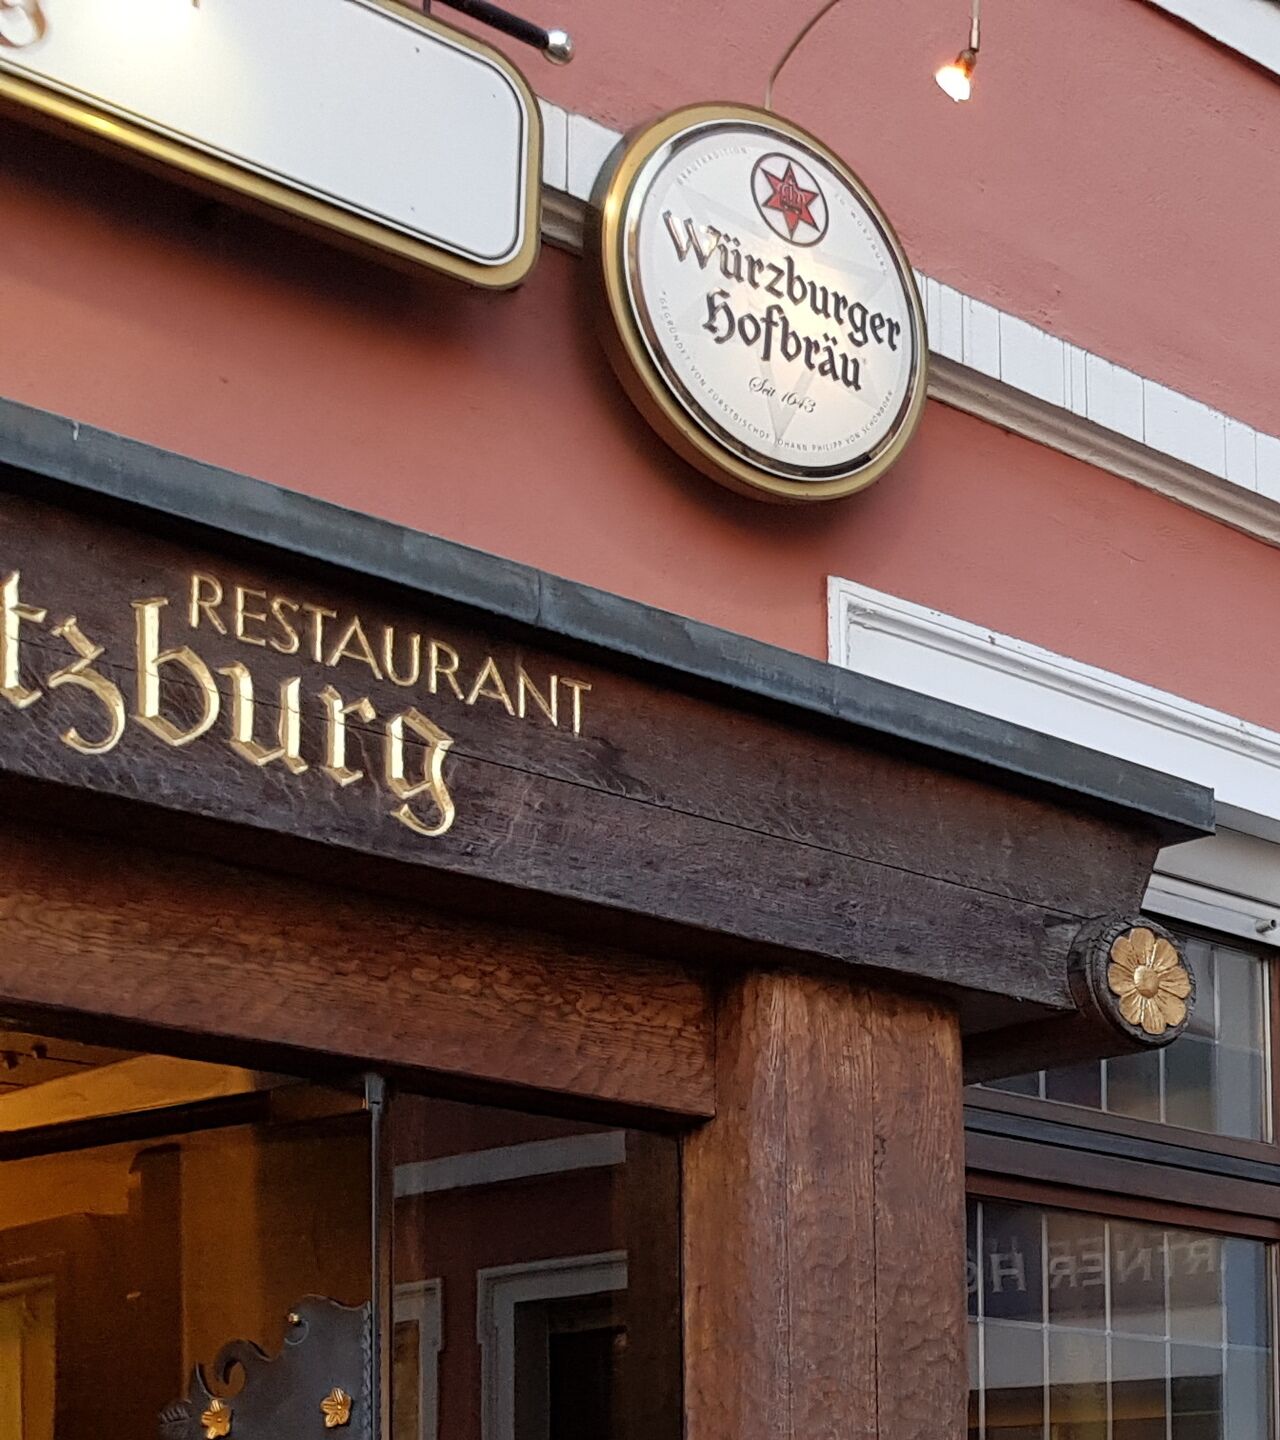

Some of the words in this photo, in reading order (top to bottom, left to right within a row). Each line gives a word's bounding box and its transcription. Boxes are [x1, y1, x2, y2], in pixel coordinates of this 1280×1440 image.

[662, 209, 901, 351] Würzburger
[702, 286, 862, 392] Hofbräu
[748, 376, 777, 398] Seit
[781, 391, 817, 414] 1643
[189, 573, 593, 737] RESTAURANT
